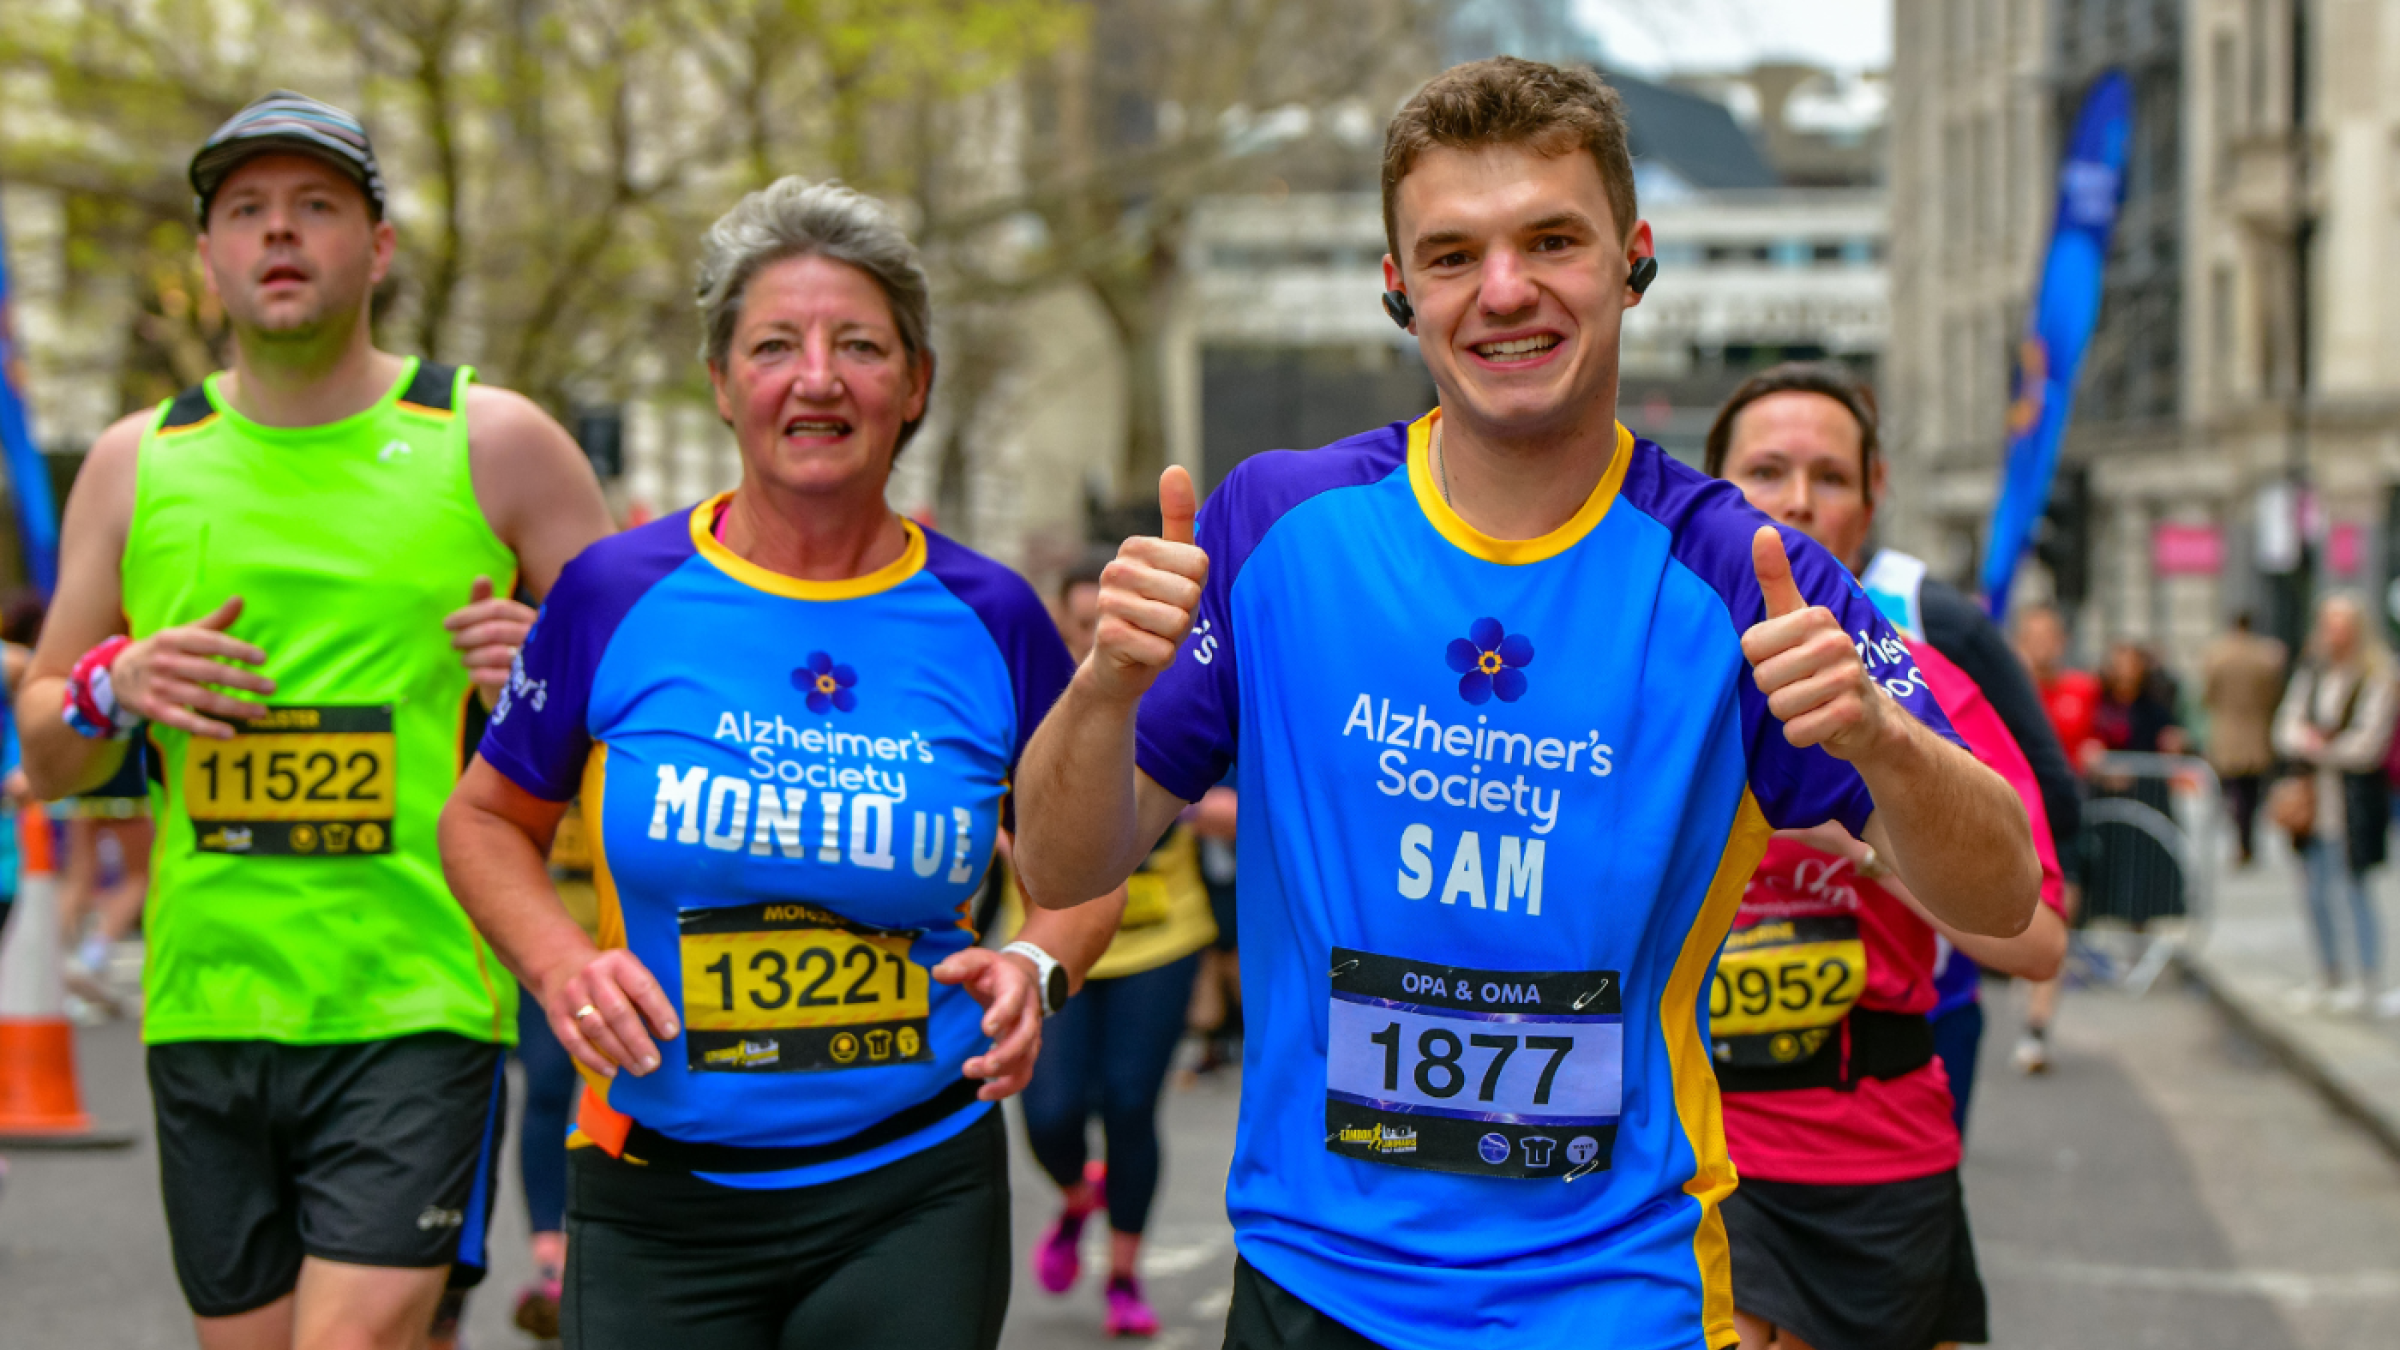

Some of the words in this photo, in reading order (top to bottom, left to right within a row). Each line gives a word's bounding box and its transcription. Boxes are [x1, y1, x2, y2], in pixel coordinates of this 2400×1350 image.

[714, 711, 935, 764] Alzheimer's
[1343, 693, 1614, 777] Alzheimer's
[199, 749, 381, 803] 11522
[749, 746, 907, 803] Society
[1376, 749, 1561, 835] Society
[1397, 823, 1546, 916] SAM
[705, 943, 907, 1011] 13221
[1402, 971, 1448, 998] OPA
[1454, 980, 1473, 1001] &
[1480, 982, 1542, 1004] OMA
[1709, 957, 1858, 1018] 0952
[1370, 1022, 1575, 1105] 1877
